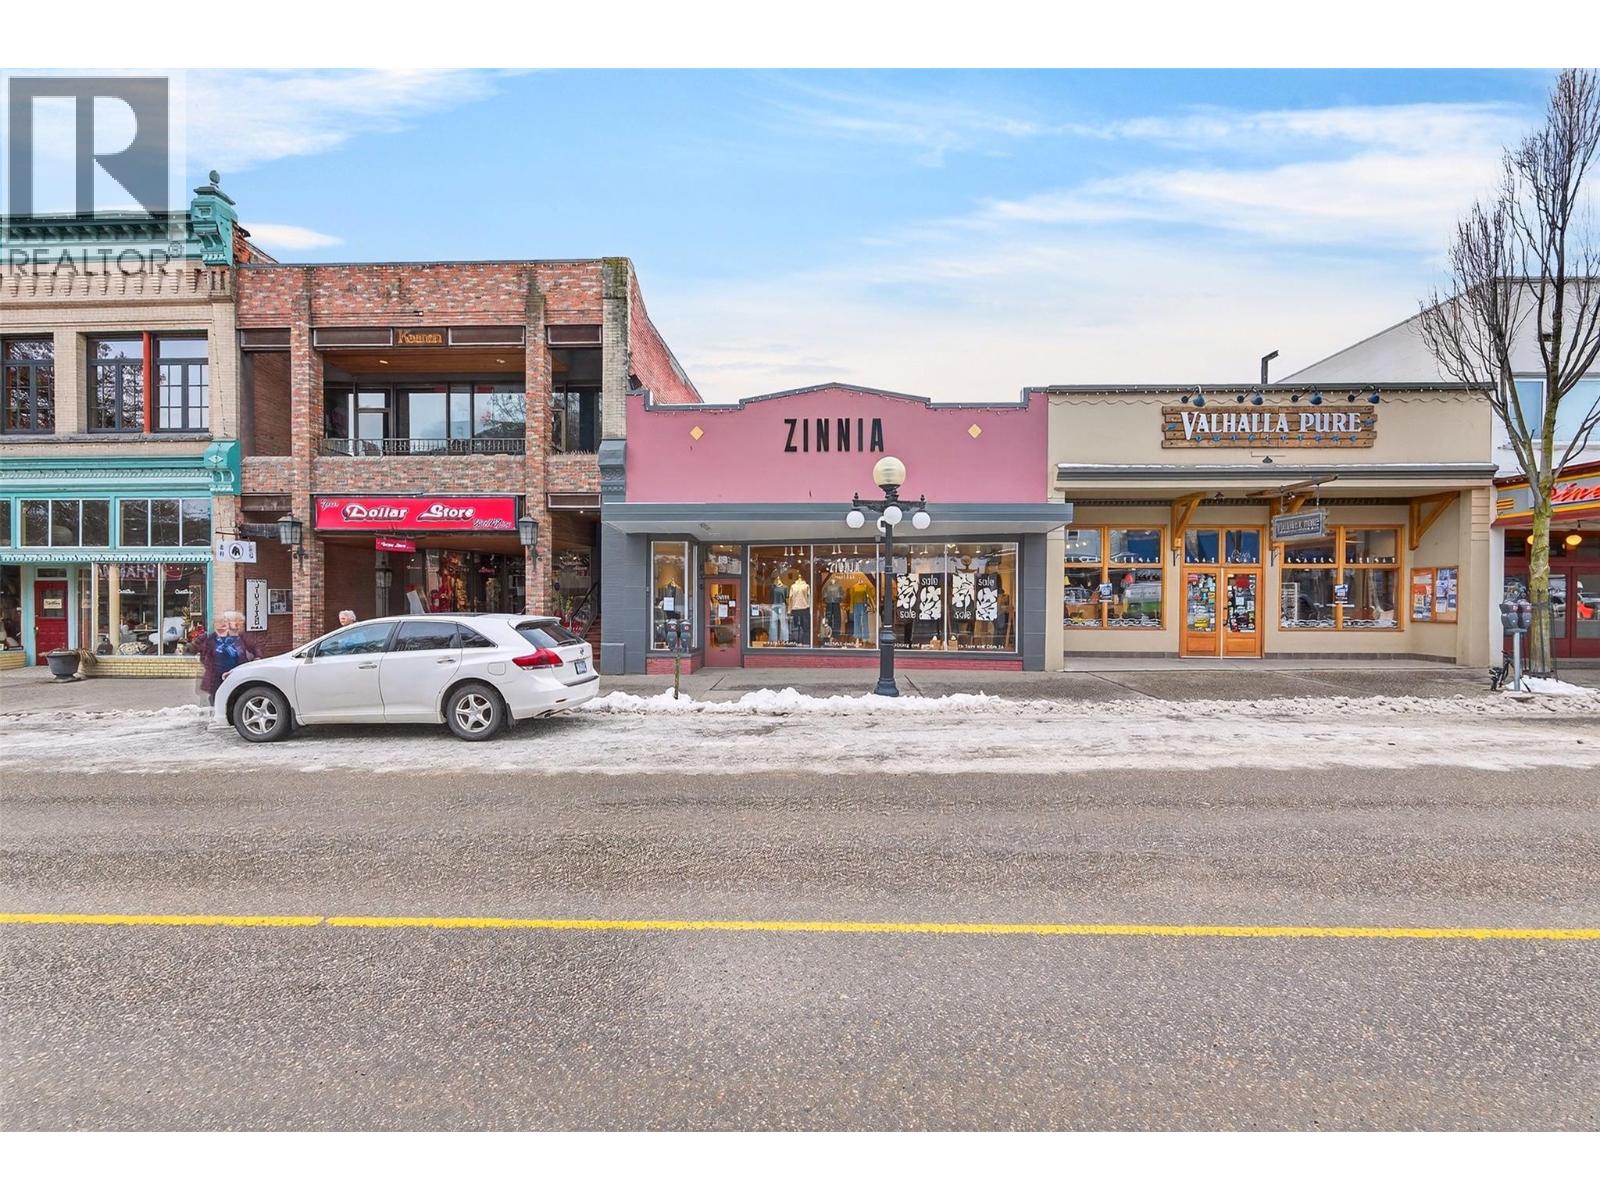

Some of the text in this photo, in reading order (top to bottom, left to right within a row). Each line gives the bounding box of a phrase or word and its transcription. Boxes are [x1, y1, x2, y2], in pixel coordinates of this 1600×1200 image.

[1180, 411, 1290, 441] VALHALLA
[1299, 412, 1363, 433] PURE
[784, 418, 884, 453] ZINNIA
[343, 502, 476, 521] Dollar Store
[921, 576, 939, 586] sale
[977, 576, 995, 587] sale
[899, 610, 917, 619] sale
[954, 610, 972, 619] sale
